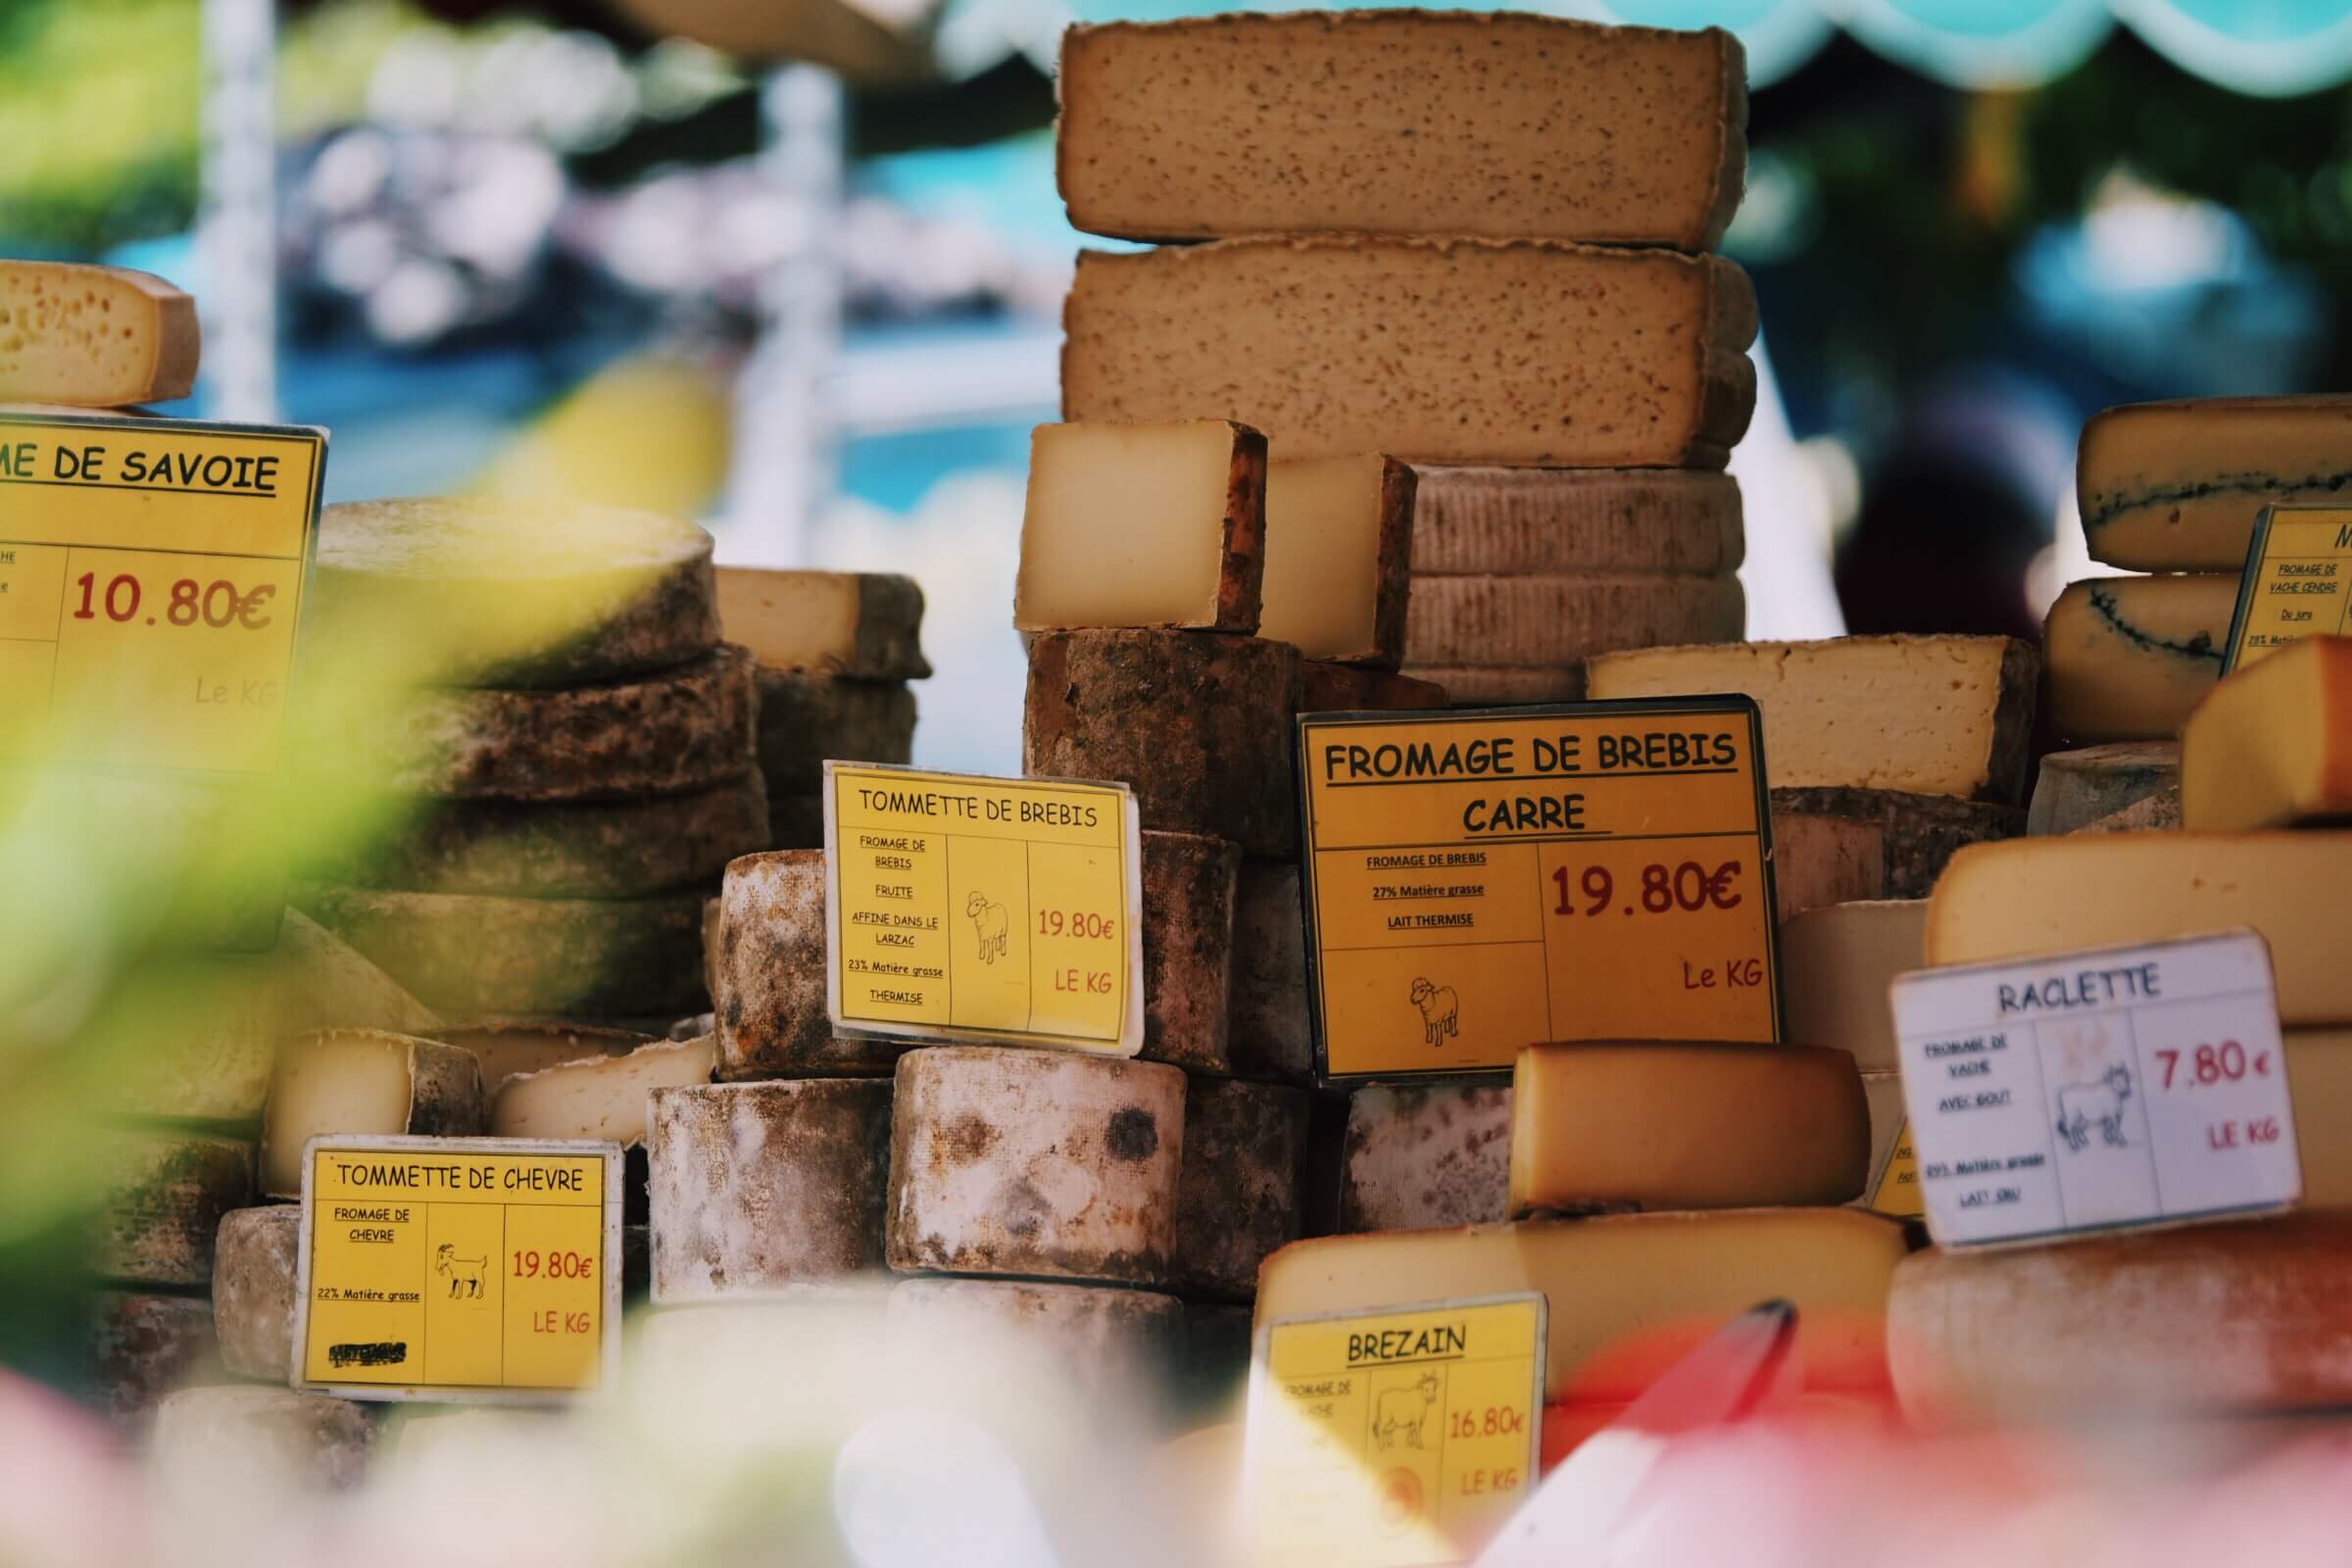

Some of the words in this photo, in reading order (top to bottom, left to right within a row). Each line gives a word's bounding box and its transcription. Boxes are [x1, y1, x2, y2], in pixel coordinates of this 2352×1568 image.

[54, 446, 106, 481] DE
[120, 451, 279, 491] SAVOIE
[2279, 564, 2322, 575] FROMAGE
[2324, 564, 2336, 575] DE
[73, 571, 276, 630] 10.80€
[2271, 582, 2298, 594] VACHE
[2302, 582, 2336, 594] CENDRE
[195, 677, 228, 705] Le
[240, 680, 277, 707] KG
[1325, 737, 1515, 781] FROMAGE
[1532, 734, 1582, 773] DE
[1597, 732, 1738, 769] BREBIS
[858, 789, 978, 819] TOMMETTE
[986, 799, 1012, 822] DE
[1020, 801, 1098, 827] BREBIS
[1463, 793, 1586, 833] CARRE
[859, 835, 908, 851] FROMAGE
[911, 839, 926, 852] DE
[874, 856, 912, 869] BREBIS
[1367, 855, 1425, 867] FROMAGE
[1429, 854, 1444, 865] DE
[1446, 853, 1487, 864] BREBIS
[875, 884, 913, 899] FRUITE
[1373, 886, 1397, 898] 27%
[1399, 884, 1446, 897] Matière
[1448, 885, 1484, 897] grasse
[1551, 860, 1742, 917] 19.80€
[852, 911, 890, 926] AFFINE
[893, 913, 924, 927] DANS
[927, 916, 939, 929] LE
[1038, 908, 1115, 941] 19.80€
[1388, 916, 1411, 927] LAIT
[1415, 912, 1474, 926] THERMISE
[875, 933, 915, 947] LARZAC
[849, 958, 867, 971] 23%
[872, 961, 908, 974] Matière
[913, 966, 944, 977] grasse
[1683, 960, 1716, 990] Le
[1726, 957, 1763, 988] KG
[1055, 968, 1080, 993] LE
[1087, 971, 1112, 994] KG
[1998, 963, 2162, 1012] RACLETTE
[870, 990, 923, 1004] THERMISE
[2209, 1124, 2238, 1151] LE
[2246, 1116, 2280, 1145] KG
[337, 1164, 462, 1189] TOMMETTE
[468, 1167, 495, 1189] DE
[504, 1168, 583, 1192] CHEVRE
[334, 1208, 390, 1221] FROMAGE
[394, 1209, 410, 1221] DE
[349, 1229, 394, 1242] CHEVRE
[513, 1250, 593, 1280] 19.80€
[318, 1288, 339, 1299] 22%
[343, 1288, 384, 1300] Matière
[388, 1291, 419, 1302] grasse
[532, 1310, 558, 1334] LE
[564, 1312, 591, 1334] KG
[1347, 1324, 1466, 1362] BREZAIN
[1450, 1405, 1525, 1441] 16.80€
[1461, 1471, 1483, 1495] LE
[1493, 1468, 1518, 1490] KG
